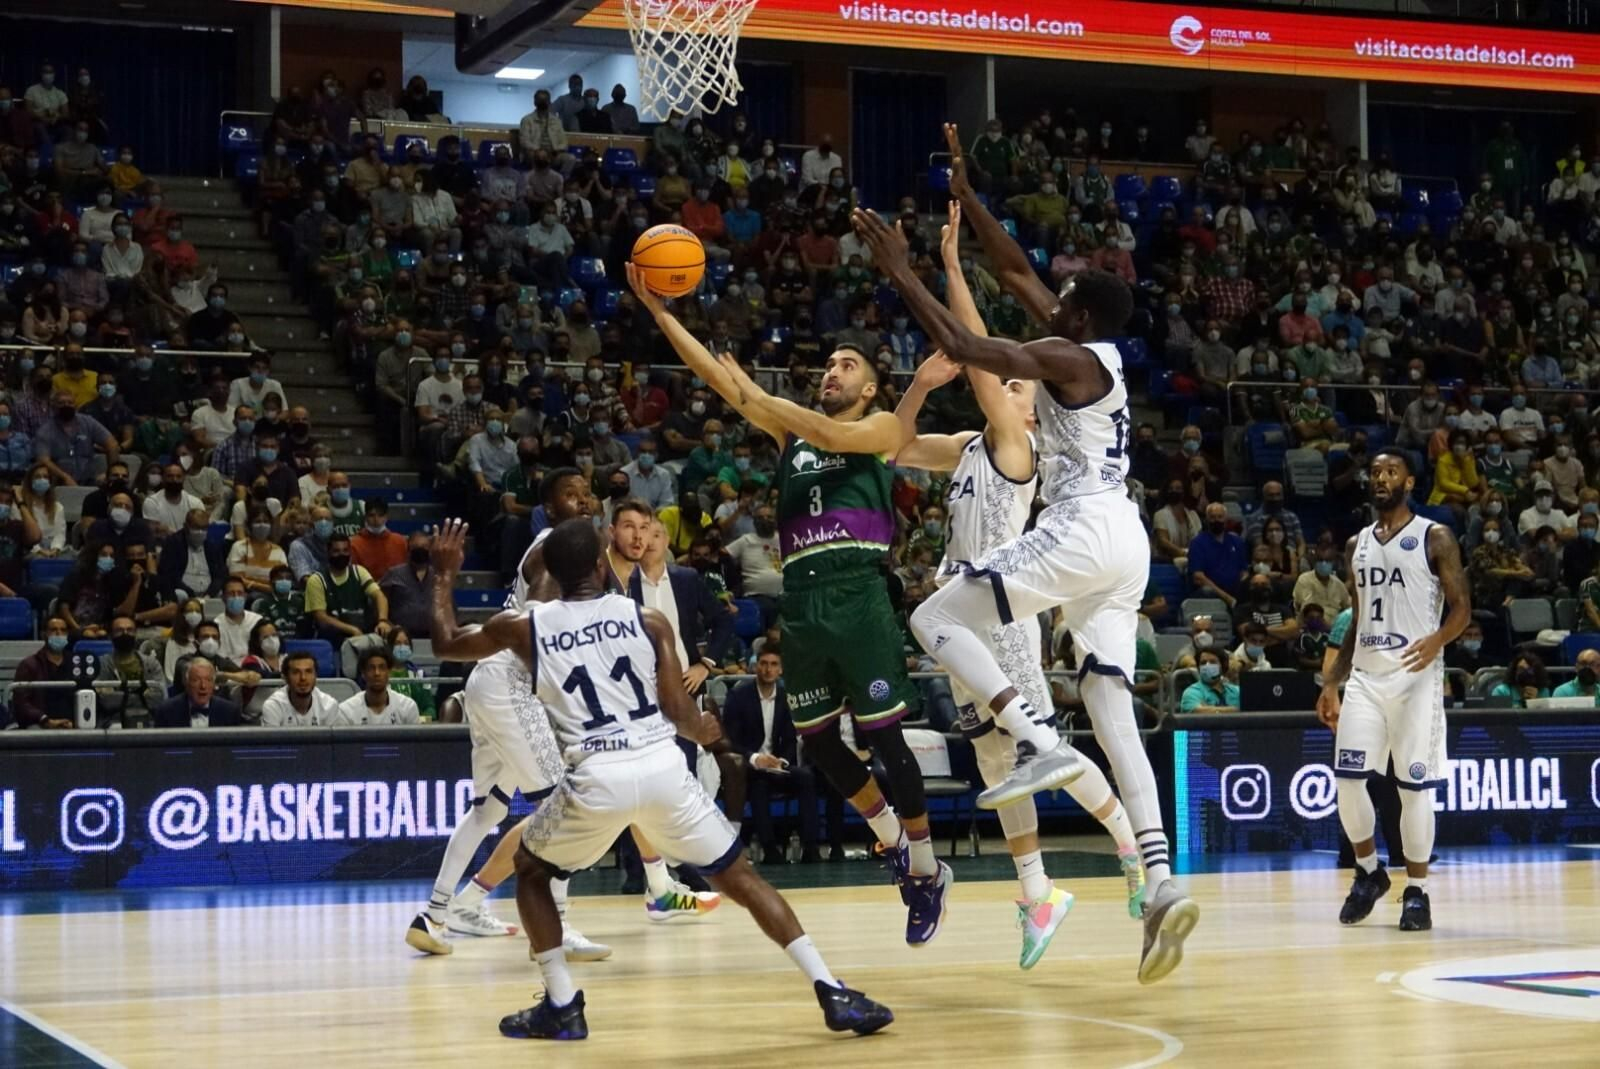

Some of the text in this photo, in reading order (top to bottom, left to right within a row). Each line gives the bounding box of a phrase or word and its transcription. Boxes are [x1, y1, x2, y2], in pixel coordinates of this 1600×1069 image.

[839, 1, 1084, 36] visitacostadelsol.com
[1210, 28, 1271, 41] COSTA DEL SOL
[1354, 38, 1575, 68] visitacostadelsol.com
[813, 454, 846, 469] Unicaja
[809, 485, 823, 517] 3
[792, 522, 852, 550] Andalucía
[1358, 567, 1406, 588] JDA
[1371, 597, 1384, 622] 1
[541, 620, 638, 655] HOLSTON
[562, 655, 659, 731] 11
[584, 738, 629, 751] DELIN
